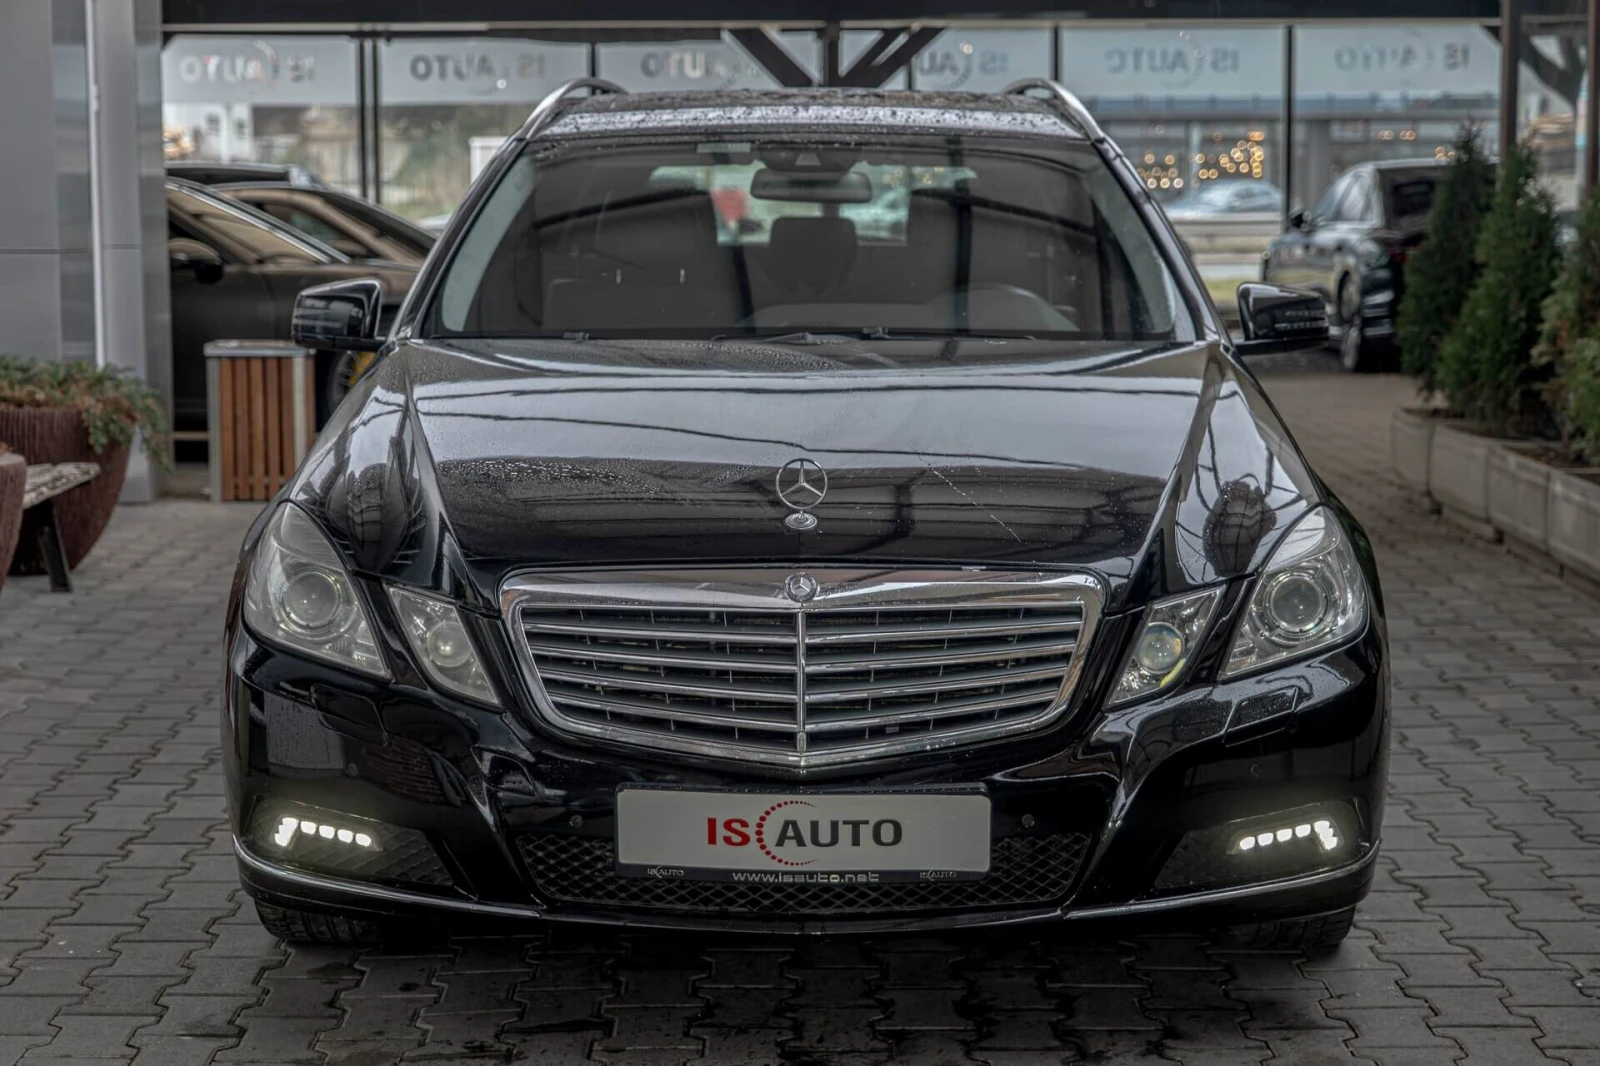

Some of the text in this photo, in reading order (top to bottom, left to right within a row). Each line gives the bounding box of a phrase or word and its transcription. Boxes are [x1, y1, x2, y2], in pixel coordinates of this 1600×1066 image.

[706, 816, 903, 848] IS AUTO
[732, 871, 880, 883] www.isauto.net
